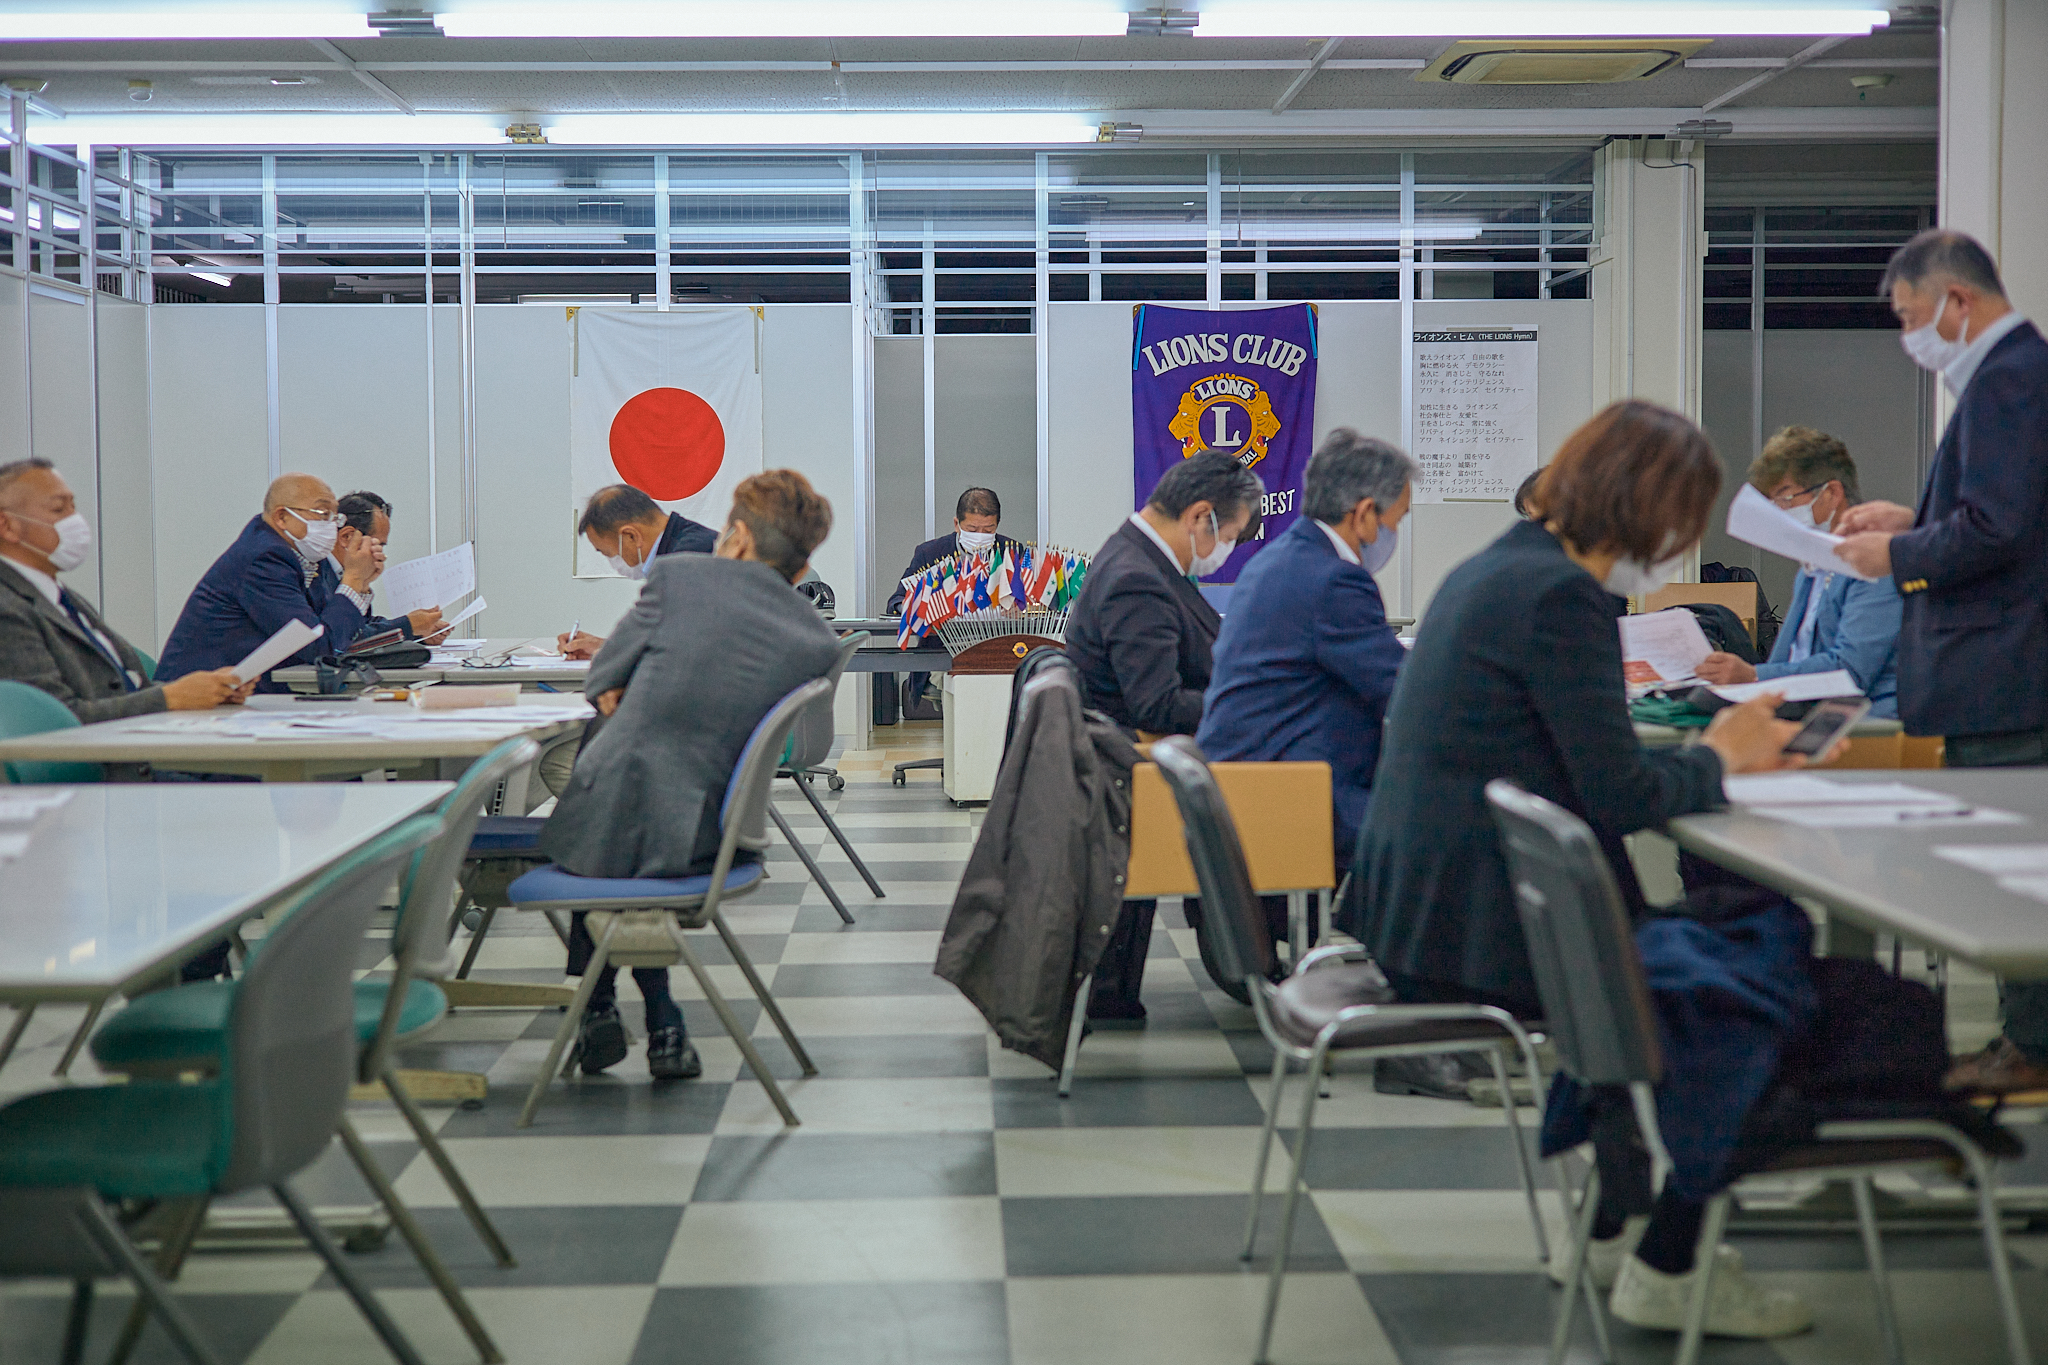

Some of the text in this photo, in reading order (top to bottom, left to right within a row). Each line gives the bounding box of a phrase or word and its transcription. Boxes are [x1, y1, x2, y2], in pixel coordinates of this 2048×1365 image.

[1414, 333, 1474, 341] ライオンズ・ヒム
[1142, 333, 1307, 377] LIONS CLUB
[1195, 378, 1254, 400] LIONS
[1211, 406, 1242, 447] L
[1260, 489, 1295, 516] BEST
